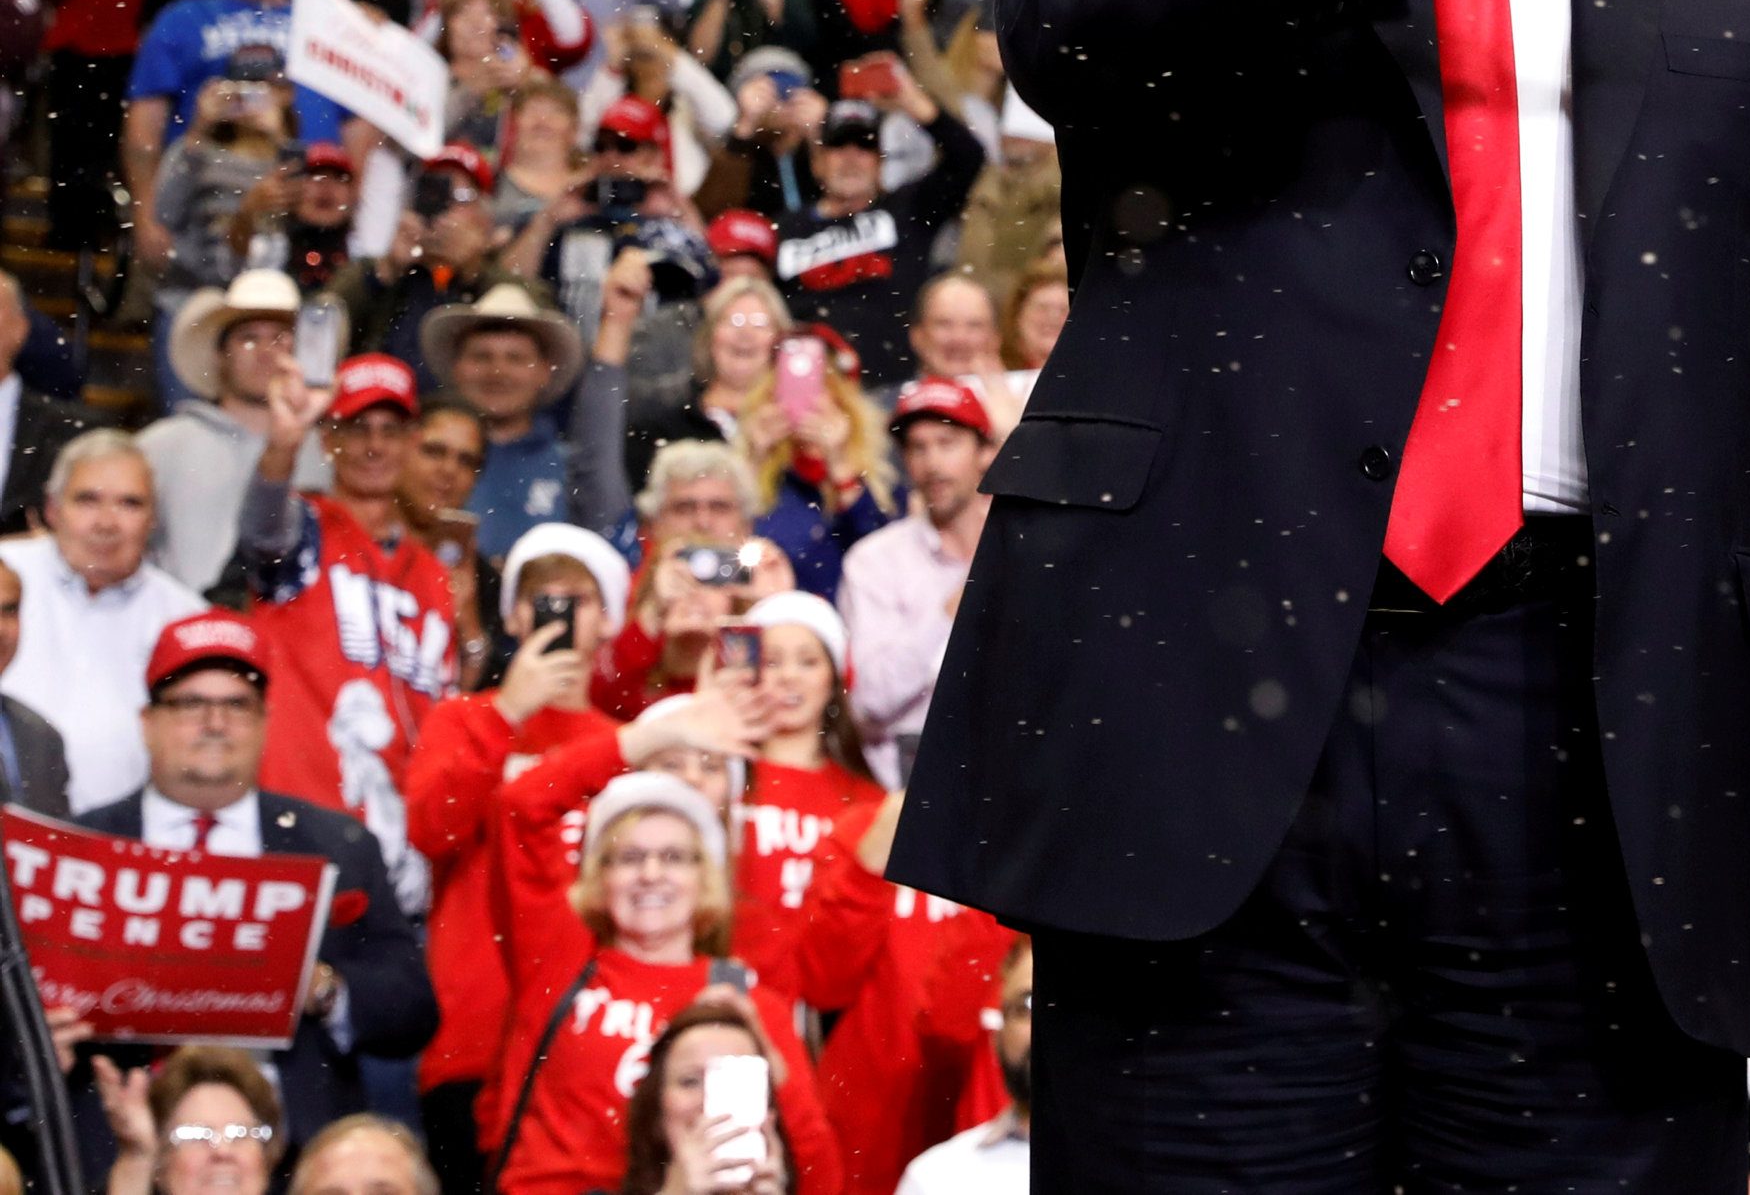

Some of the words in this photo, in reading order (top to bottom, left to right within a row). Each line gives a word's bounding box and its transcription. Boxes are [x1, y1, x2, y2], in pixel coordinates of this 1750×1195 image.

[5, 840, 308, 922] TRUMP
[21, 893, 268, 951] PENCE
[101, 977, 287, 1015] Christmas
[572, 986, 669, 1046] TRU
